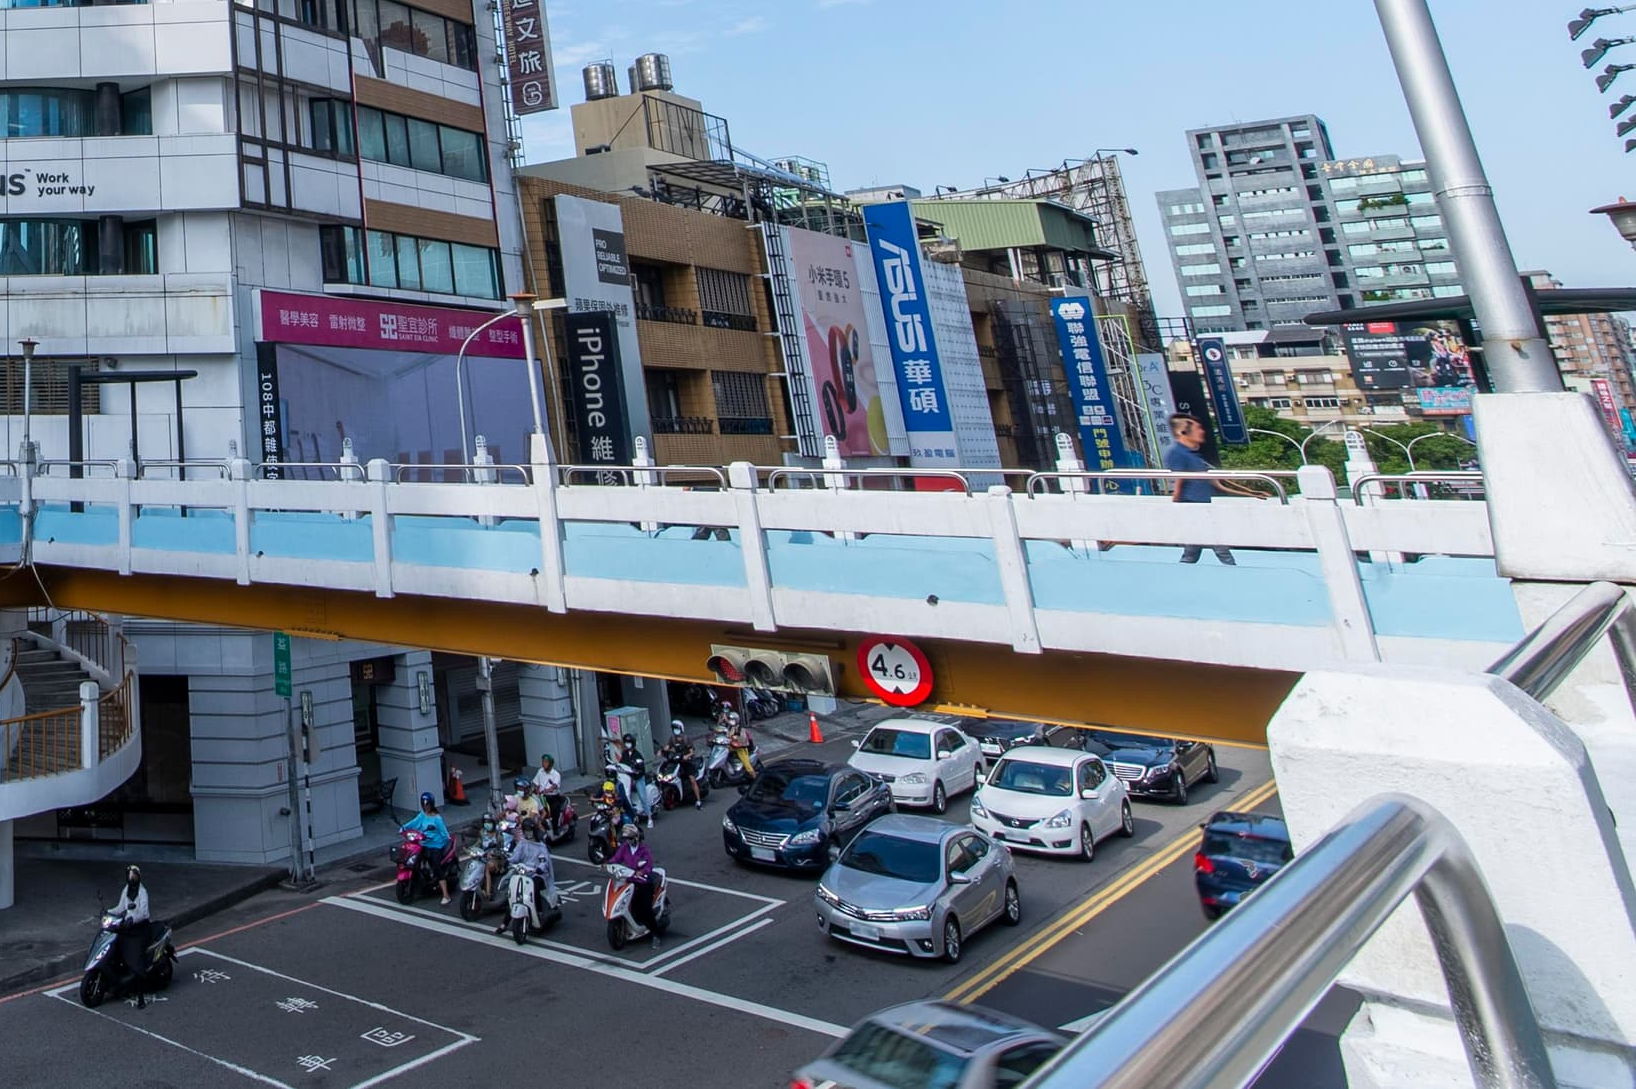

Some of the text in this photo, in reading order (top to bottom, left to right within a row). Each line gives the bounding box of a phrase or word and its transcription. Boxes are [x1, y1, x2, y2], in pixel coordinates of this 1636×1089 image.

[36, 173, 69, 184] Work
[37, 185, 95, 198] your way
[595, 239, 607, 249] PRO
[596, 251, 621, 263] RELIABLE
[598, 262, 627, 275] OPTIMIZED
[279, 309, 367, 332] 醫學美容 雷射微整
[398, 314, 438, 337] 聖宜診所
[1066, 322, 1101, 401] 聯強電信聯盟
[577, 327, 606, 428] iPhone
[902, 359, 940, 414] 華碩
[871, 653, 906, 680] 4.6
